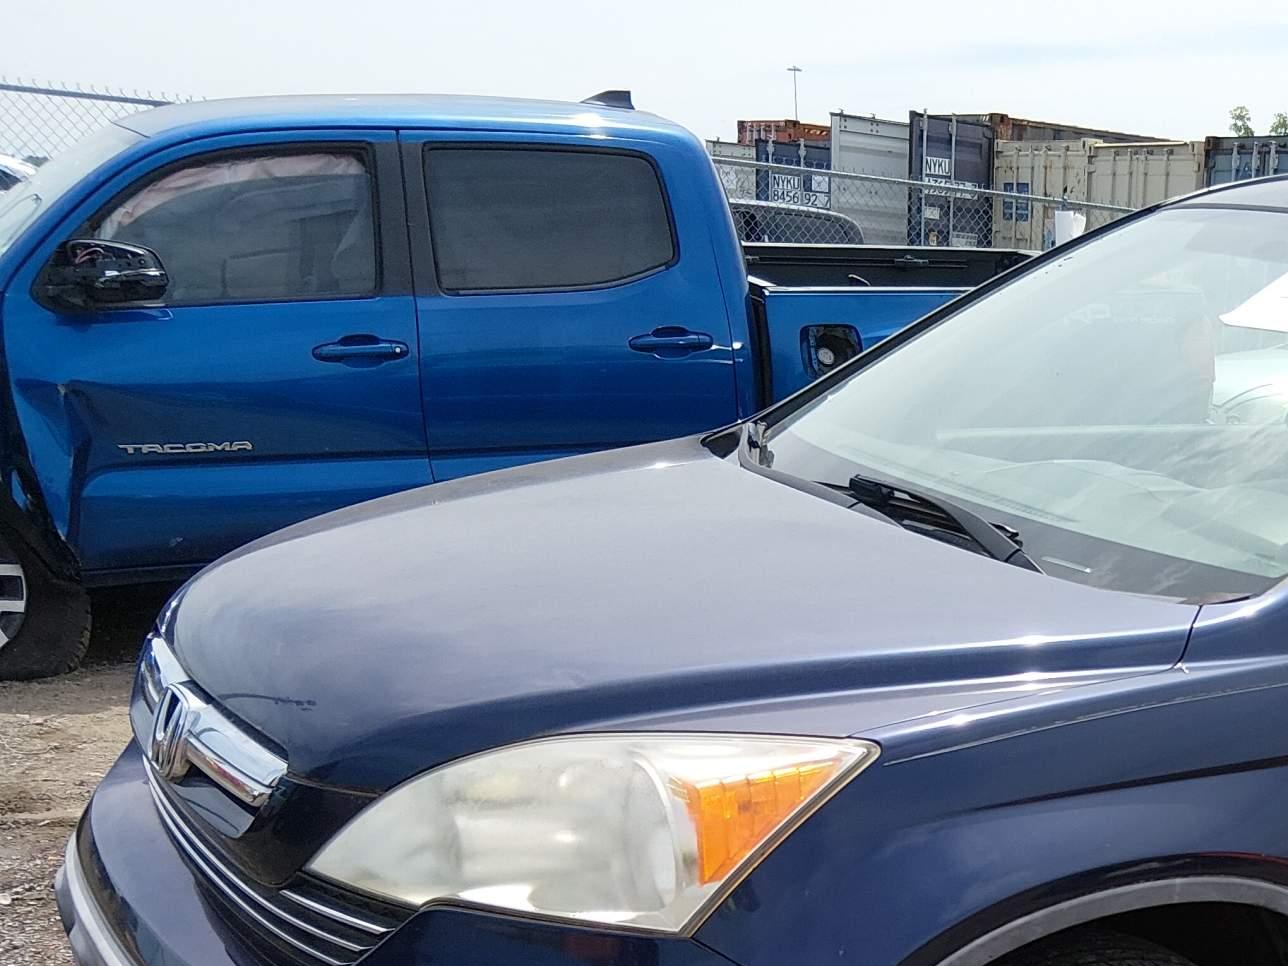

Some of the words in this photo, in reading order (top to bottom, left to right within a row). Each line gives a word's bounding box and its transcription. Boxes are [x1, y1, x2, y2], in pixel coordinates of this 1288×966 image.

[926, 157, 950, 175] NYKU
[773, 175, 800, 190] NYKU
[118, 441, 253, 454] TACOMA
